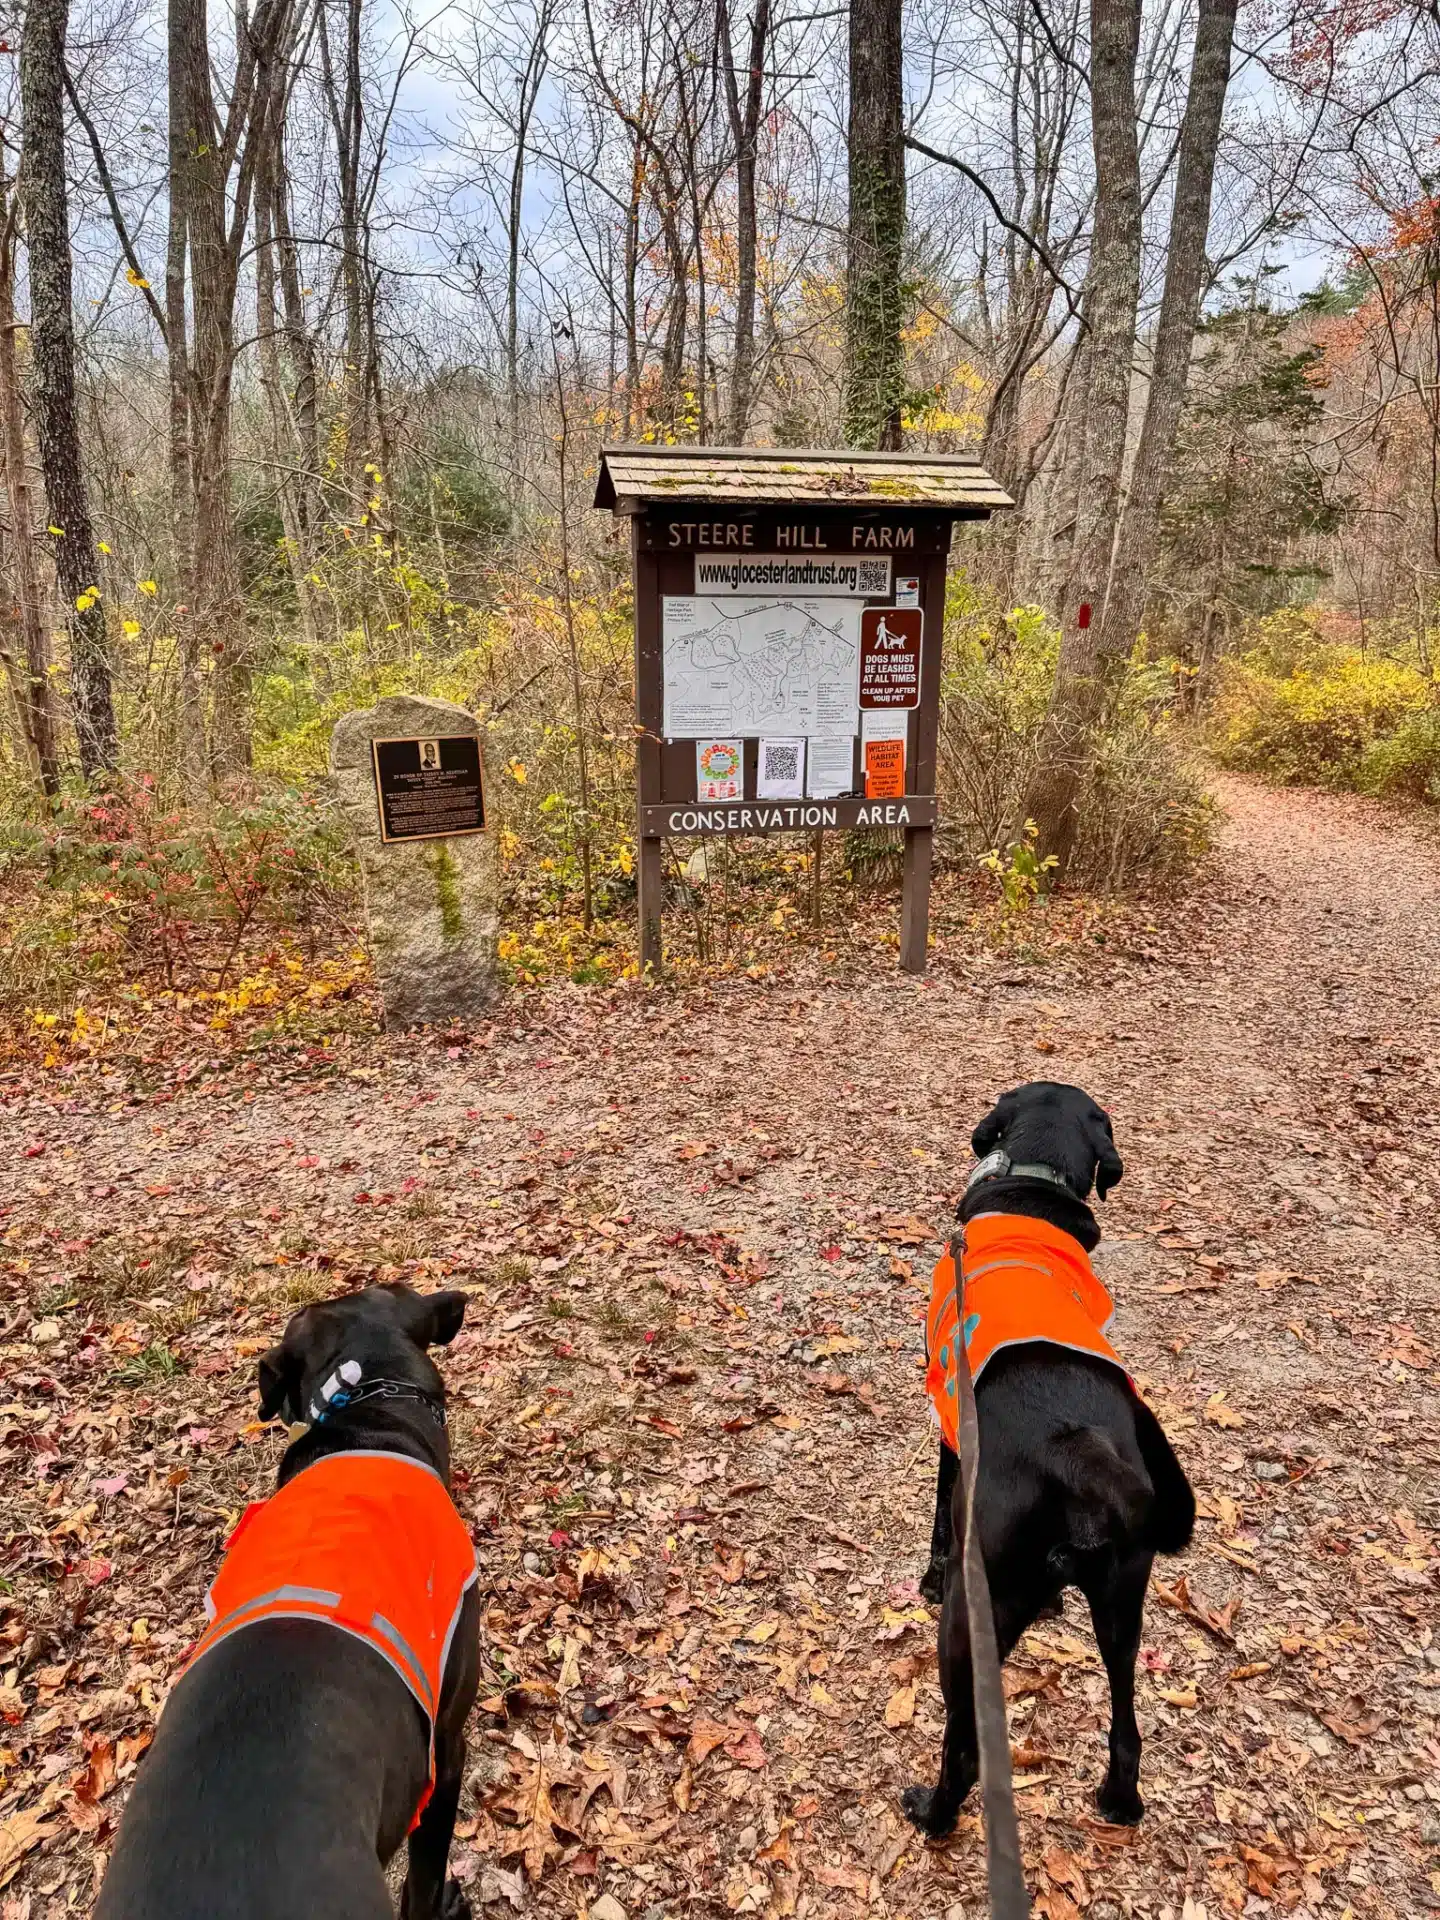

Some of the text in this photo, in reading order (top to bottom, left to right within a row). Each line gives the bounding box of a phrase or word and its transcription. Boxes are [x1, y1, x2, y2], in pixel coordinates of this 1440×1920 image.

[669, 523, 914, 548] STEERE HILL FARM
[699, 558, 857, 591] www.glocesterlandtrust.org
[865, 654, 888, 664] DOGS
[890, 654, 915, 663] MUST
[864, 664, 915, 673] BE LEASHED
[863, 673, 916, 683] AT ALL TIMES
[894, 686, 916, 694] AFTER
[873, 694, 905, 702] YOUR PET
[868, 744, 901, 753] WILDLIFE
[870, 752, 899, 761] HABITAT
[875, 761, 895, 769] AREA
[669, 805, 910, 831] CONSERVATION AREA
